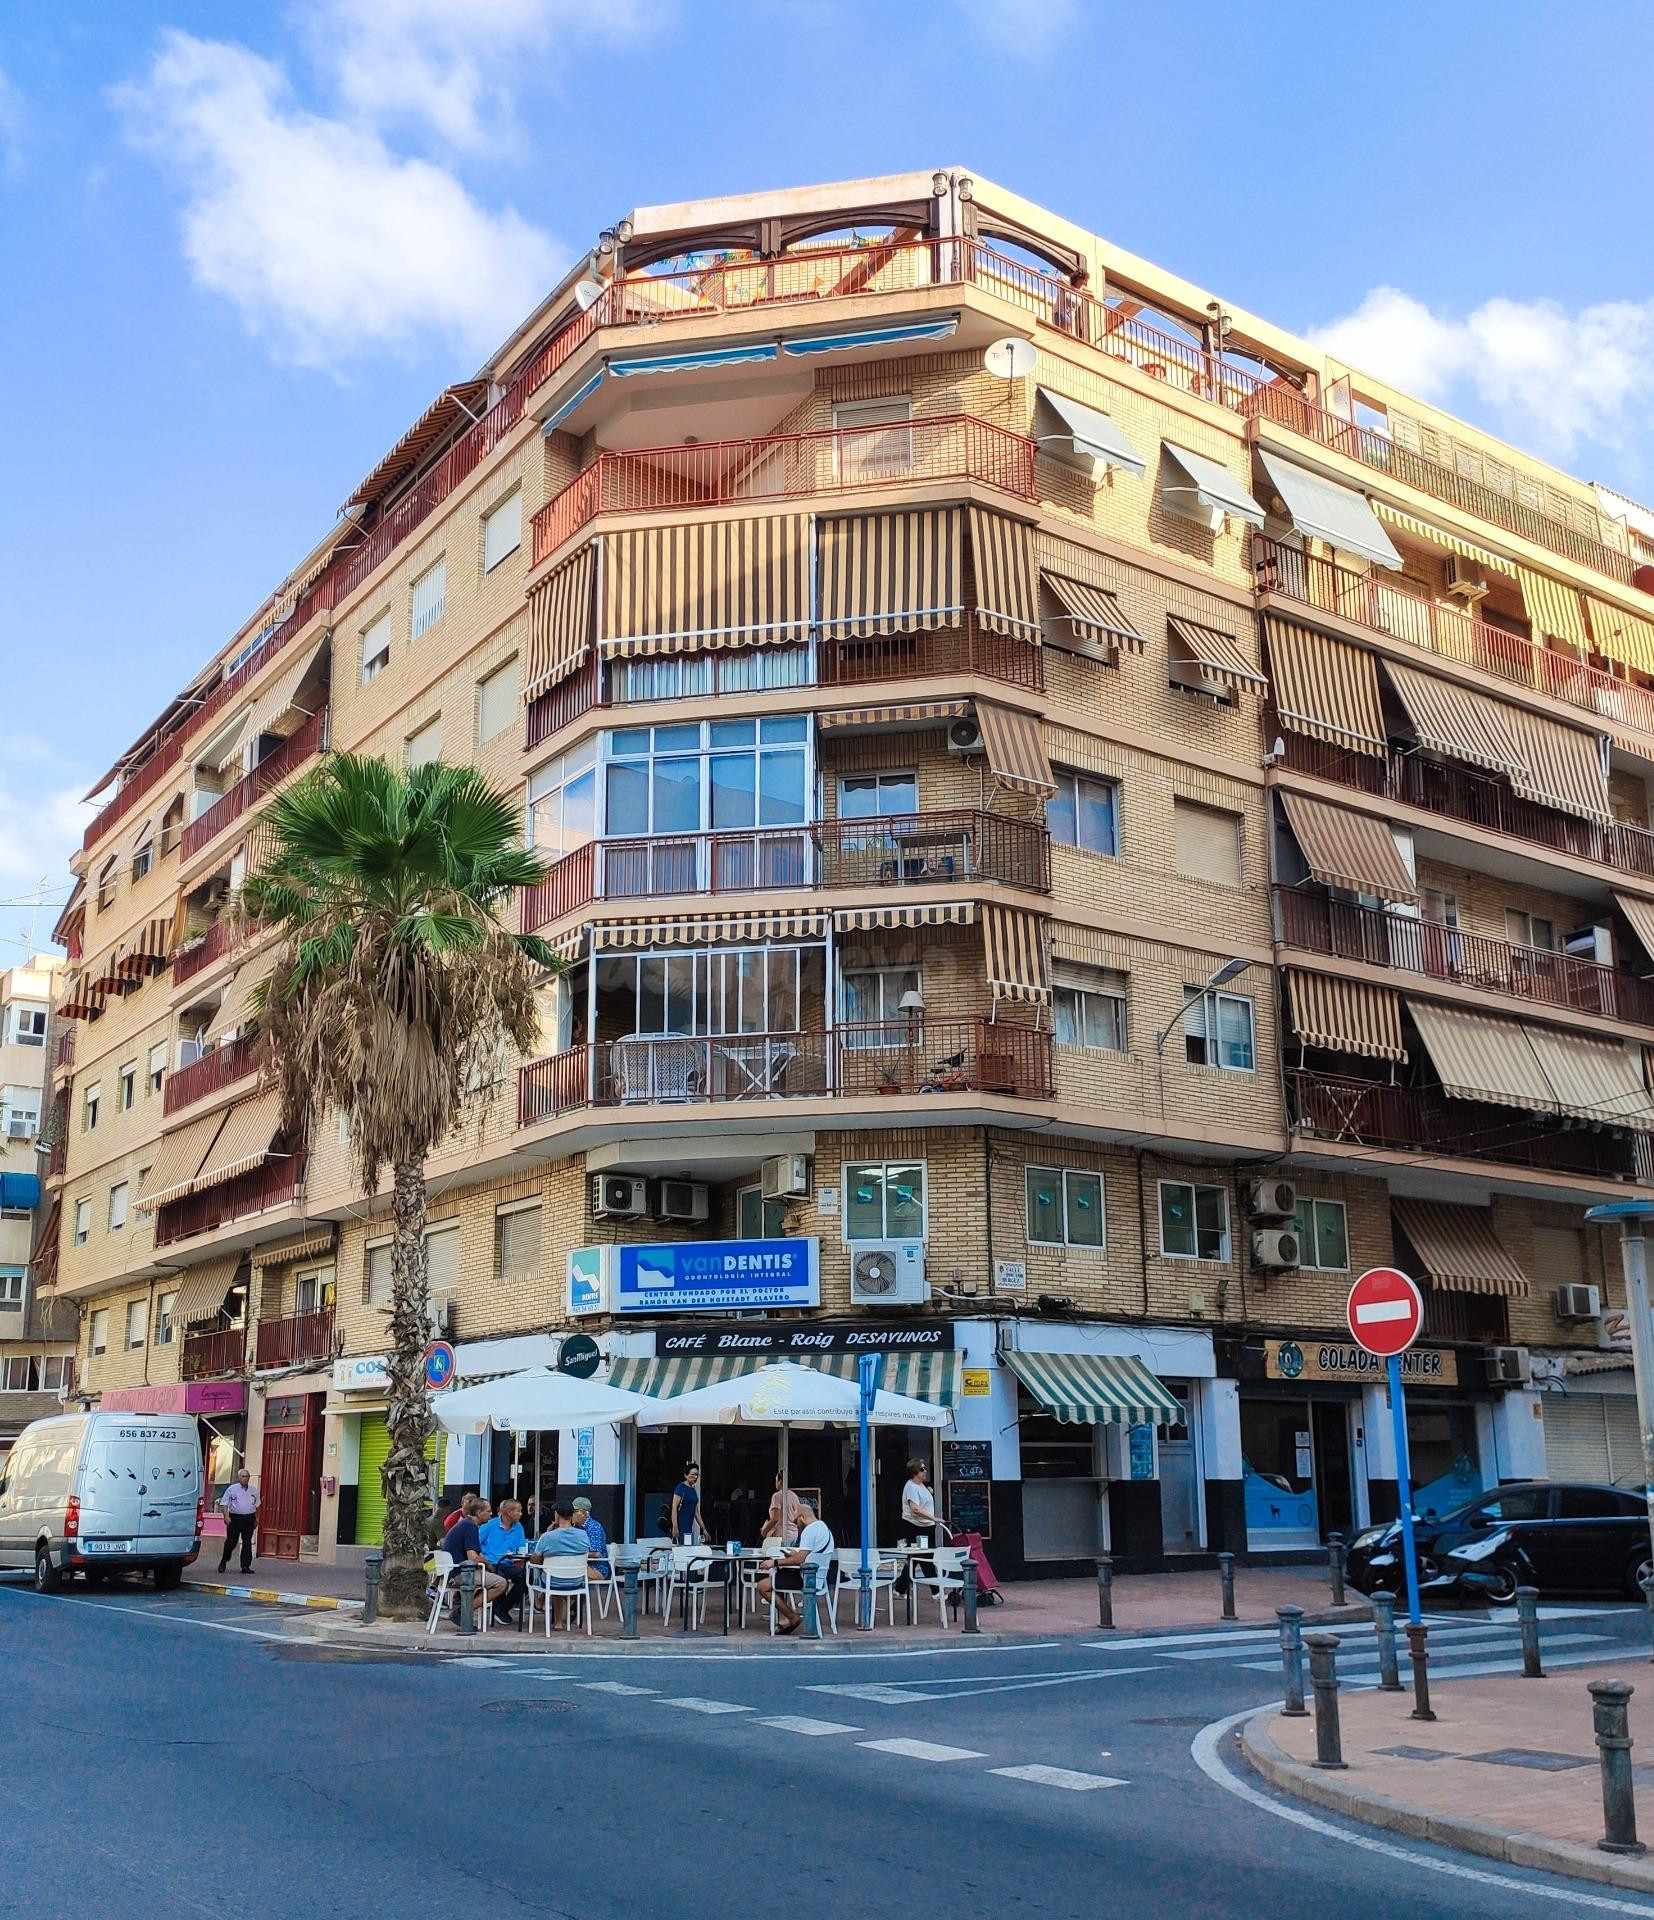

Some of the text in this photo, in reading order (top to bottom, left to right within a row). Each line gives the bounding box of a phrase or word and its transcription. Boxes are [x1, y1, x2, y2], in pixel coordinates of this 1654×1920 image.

[750, 1271, 792, 1279] INTEGRAL
[678, 1289, 716, 1297] FUNDADO
[665, 1333, 707, 1348] CAFÉ
[717, 1334, 772, 1348] Blanc
[790, 1331, 835, 1348] Roig
[845, 1330, 942, 1345] DESAYUNOS
[1317, 1345, 1442, 1377] COLADA NTER
[790, 1408, 816, 1416] parasol
[902, 1411, 916, 1419] más
[120, 1429, 177, 1439] 656 837 423
